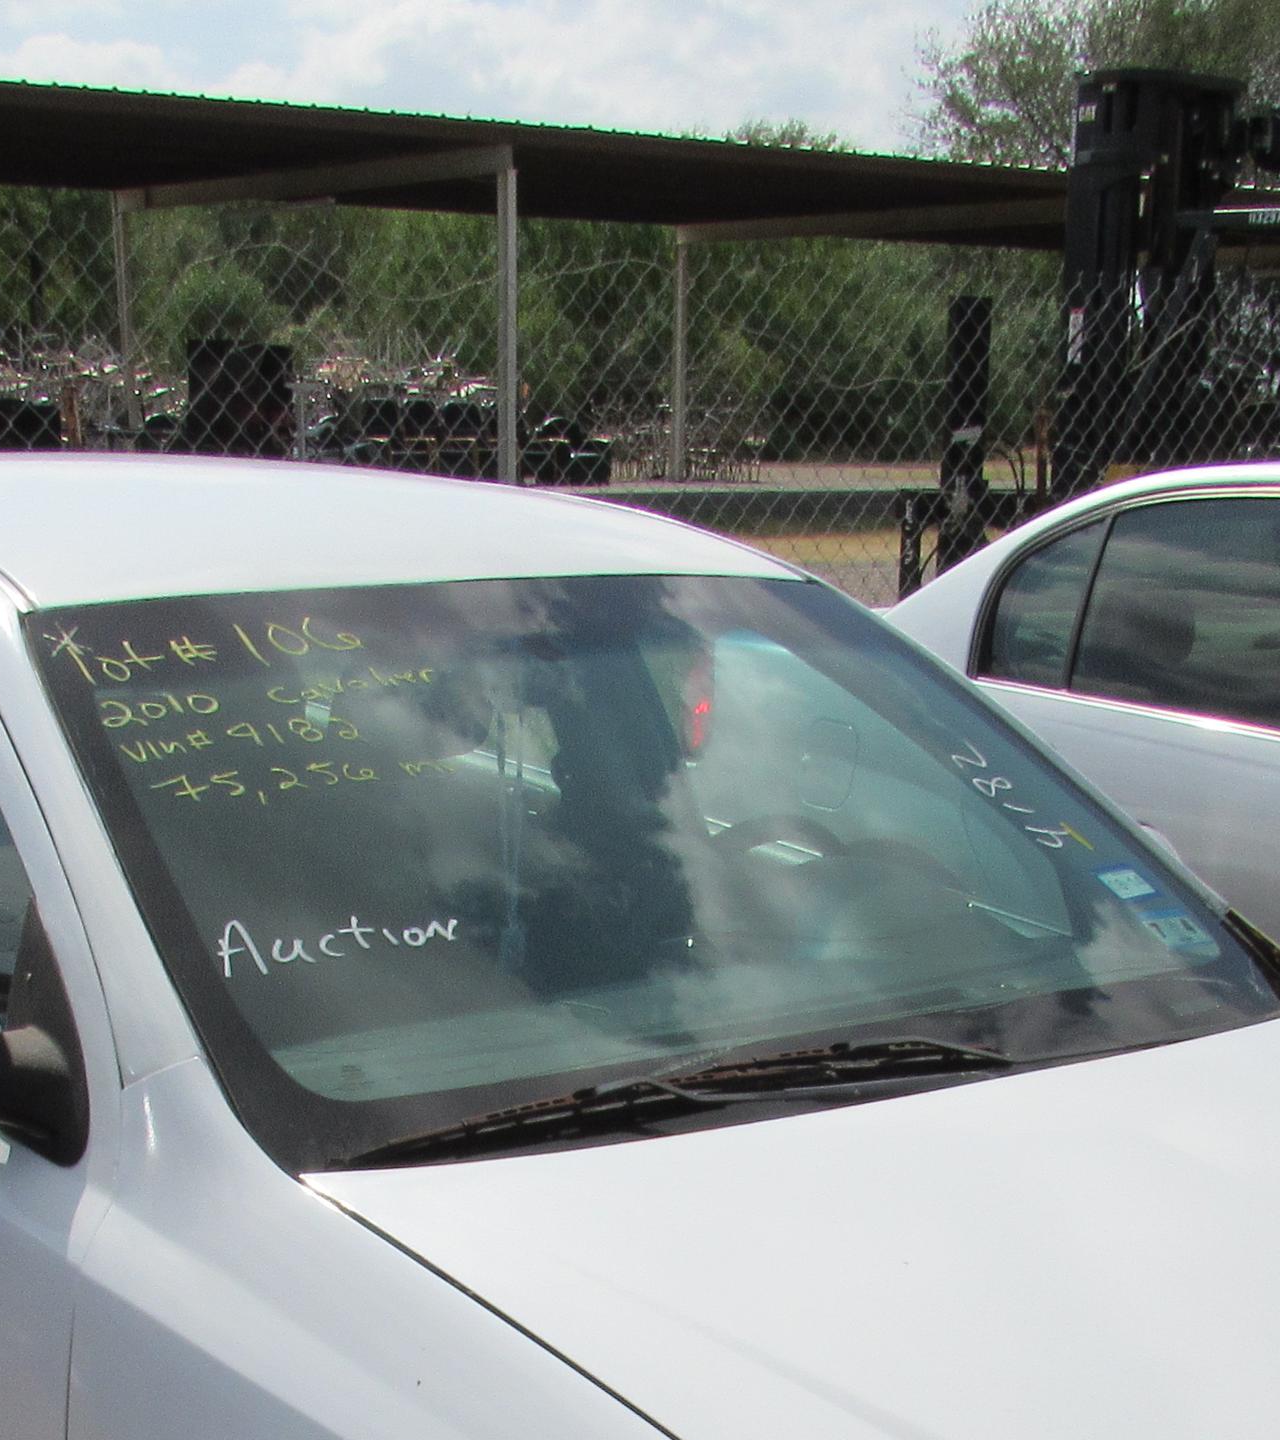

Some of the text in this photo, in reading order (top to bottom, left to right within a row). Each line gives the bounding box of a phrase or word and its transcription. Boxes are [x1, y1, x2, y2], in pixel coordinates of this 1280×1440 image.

[233, 616, 363, 667] 106
[100, 693, 220, 729] 2010
[217, 915, 458, 979] Auction
